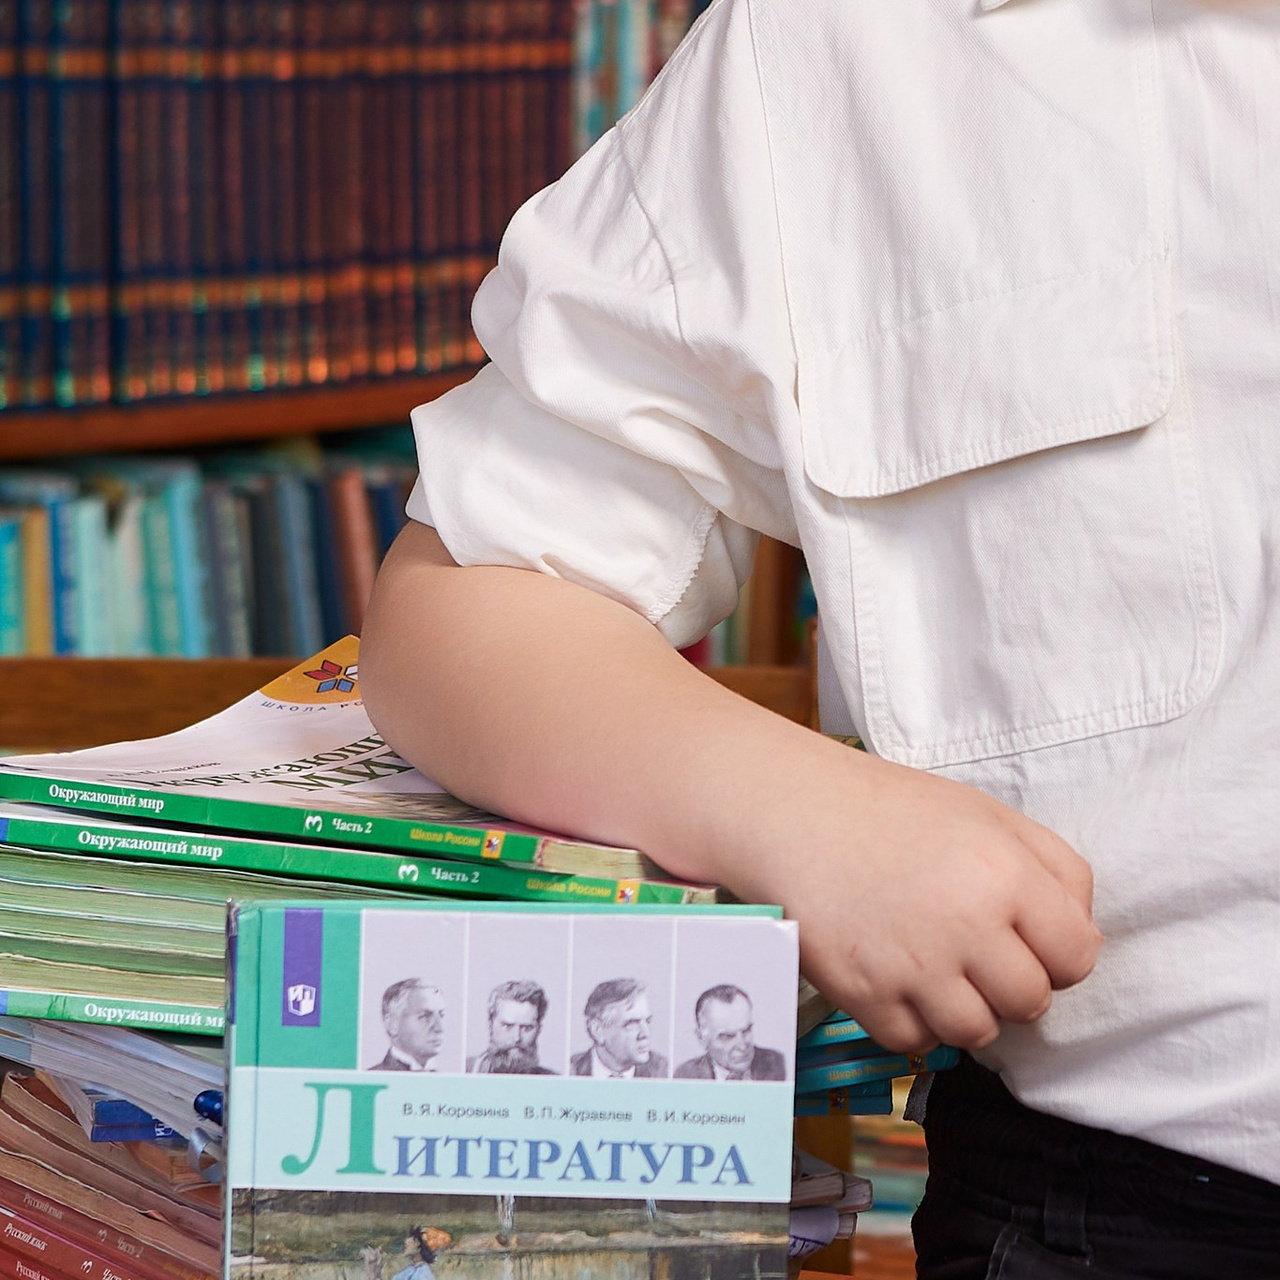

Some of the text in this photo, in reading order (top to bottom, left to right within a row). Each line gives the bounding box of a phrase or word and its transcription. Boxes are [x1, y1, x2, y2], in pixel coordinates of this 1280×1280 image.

[261, 700, 328, 713] ШКОЛА
[48, 783, 481, 848] Окружающий мир 3 Часть 2 Школа России
[77, 829, 612, 898] Окружающий мир 3 Часть 2 Школа России
[83, 1002, 202, 1029] Окружающий
[280, 1081, 755, 1187] ЛИТЕРАТУРА
[3, 1222, 33, 1246] Русский
